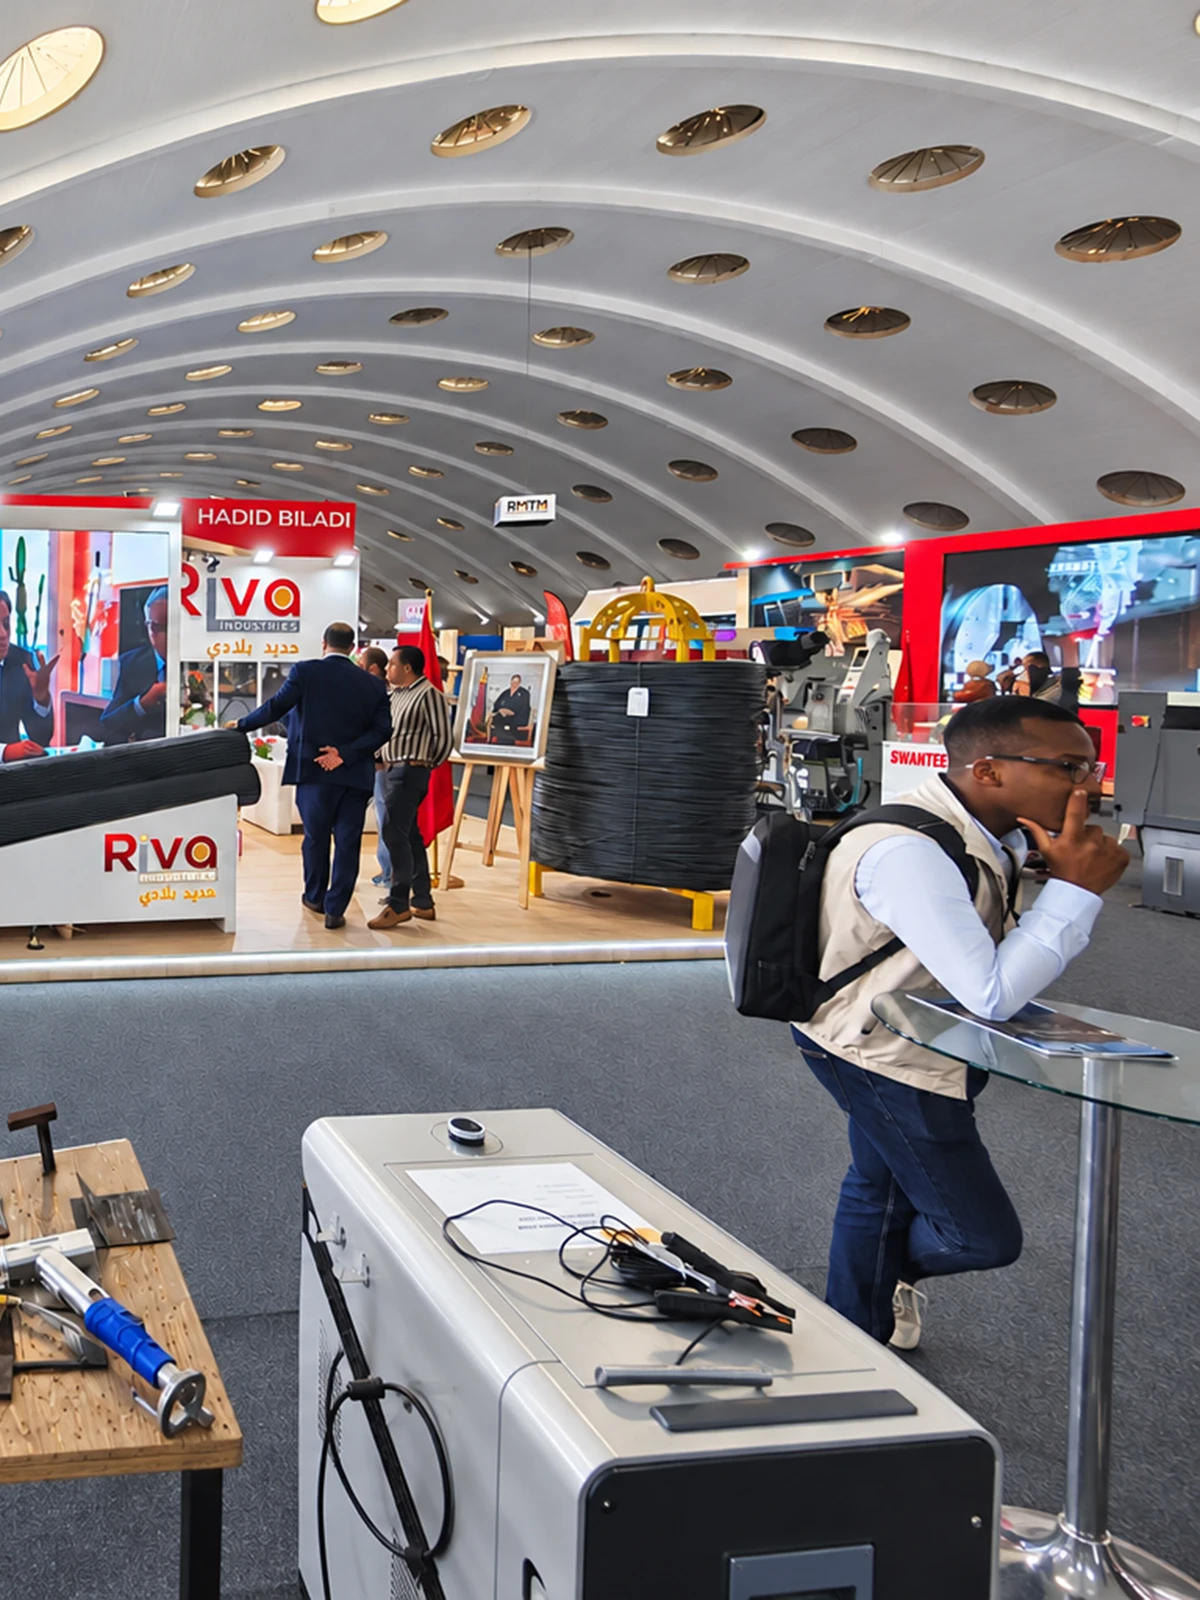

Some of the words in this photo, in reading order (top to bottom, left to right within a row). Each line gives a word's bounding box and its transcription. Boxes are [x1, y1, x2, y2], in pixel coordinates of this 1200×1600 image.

[507, 499, 548, 513] RMTM
[198, 508, 272, 526] HADID
[278, 510, 350, 528] BILADI
[219, 621, 298, 631] INDUSTRIES
[207, 638, 252, 659] بلادي
[264, 643, 299, 658] حديد
[104, 833, 218, 873] Riva
